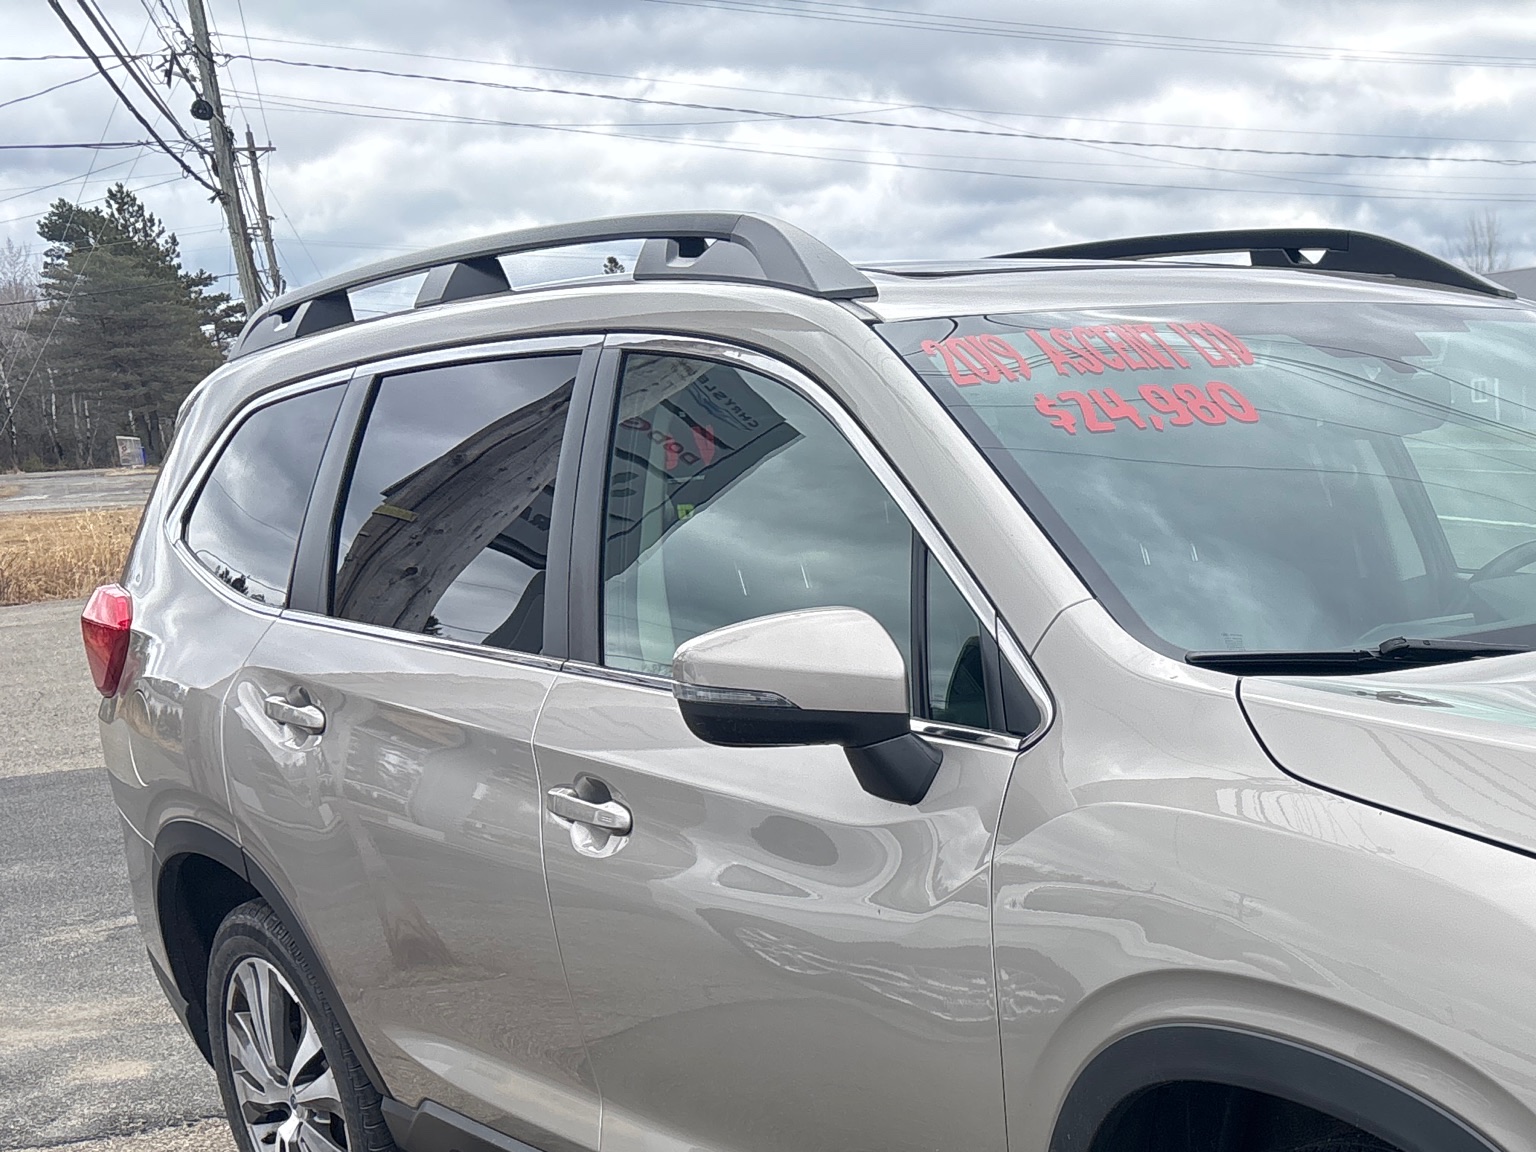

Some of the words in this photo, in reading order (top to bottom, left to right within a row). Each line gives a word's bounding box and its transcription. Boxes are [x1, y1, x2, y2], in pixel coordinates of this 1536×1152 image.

[921, 332, 1031, 387] 2019
[1025, 323, 1191, 376] ASCENT
[1167, 321, 1256, 368] LTD
[1034, 381, 1261, 435] $24,980
